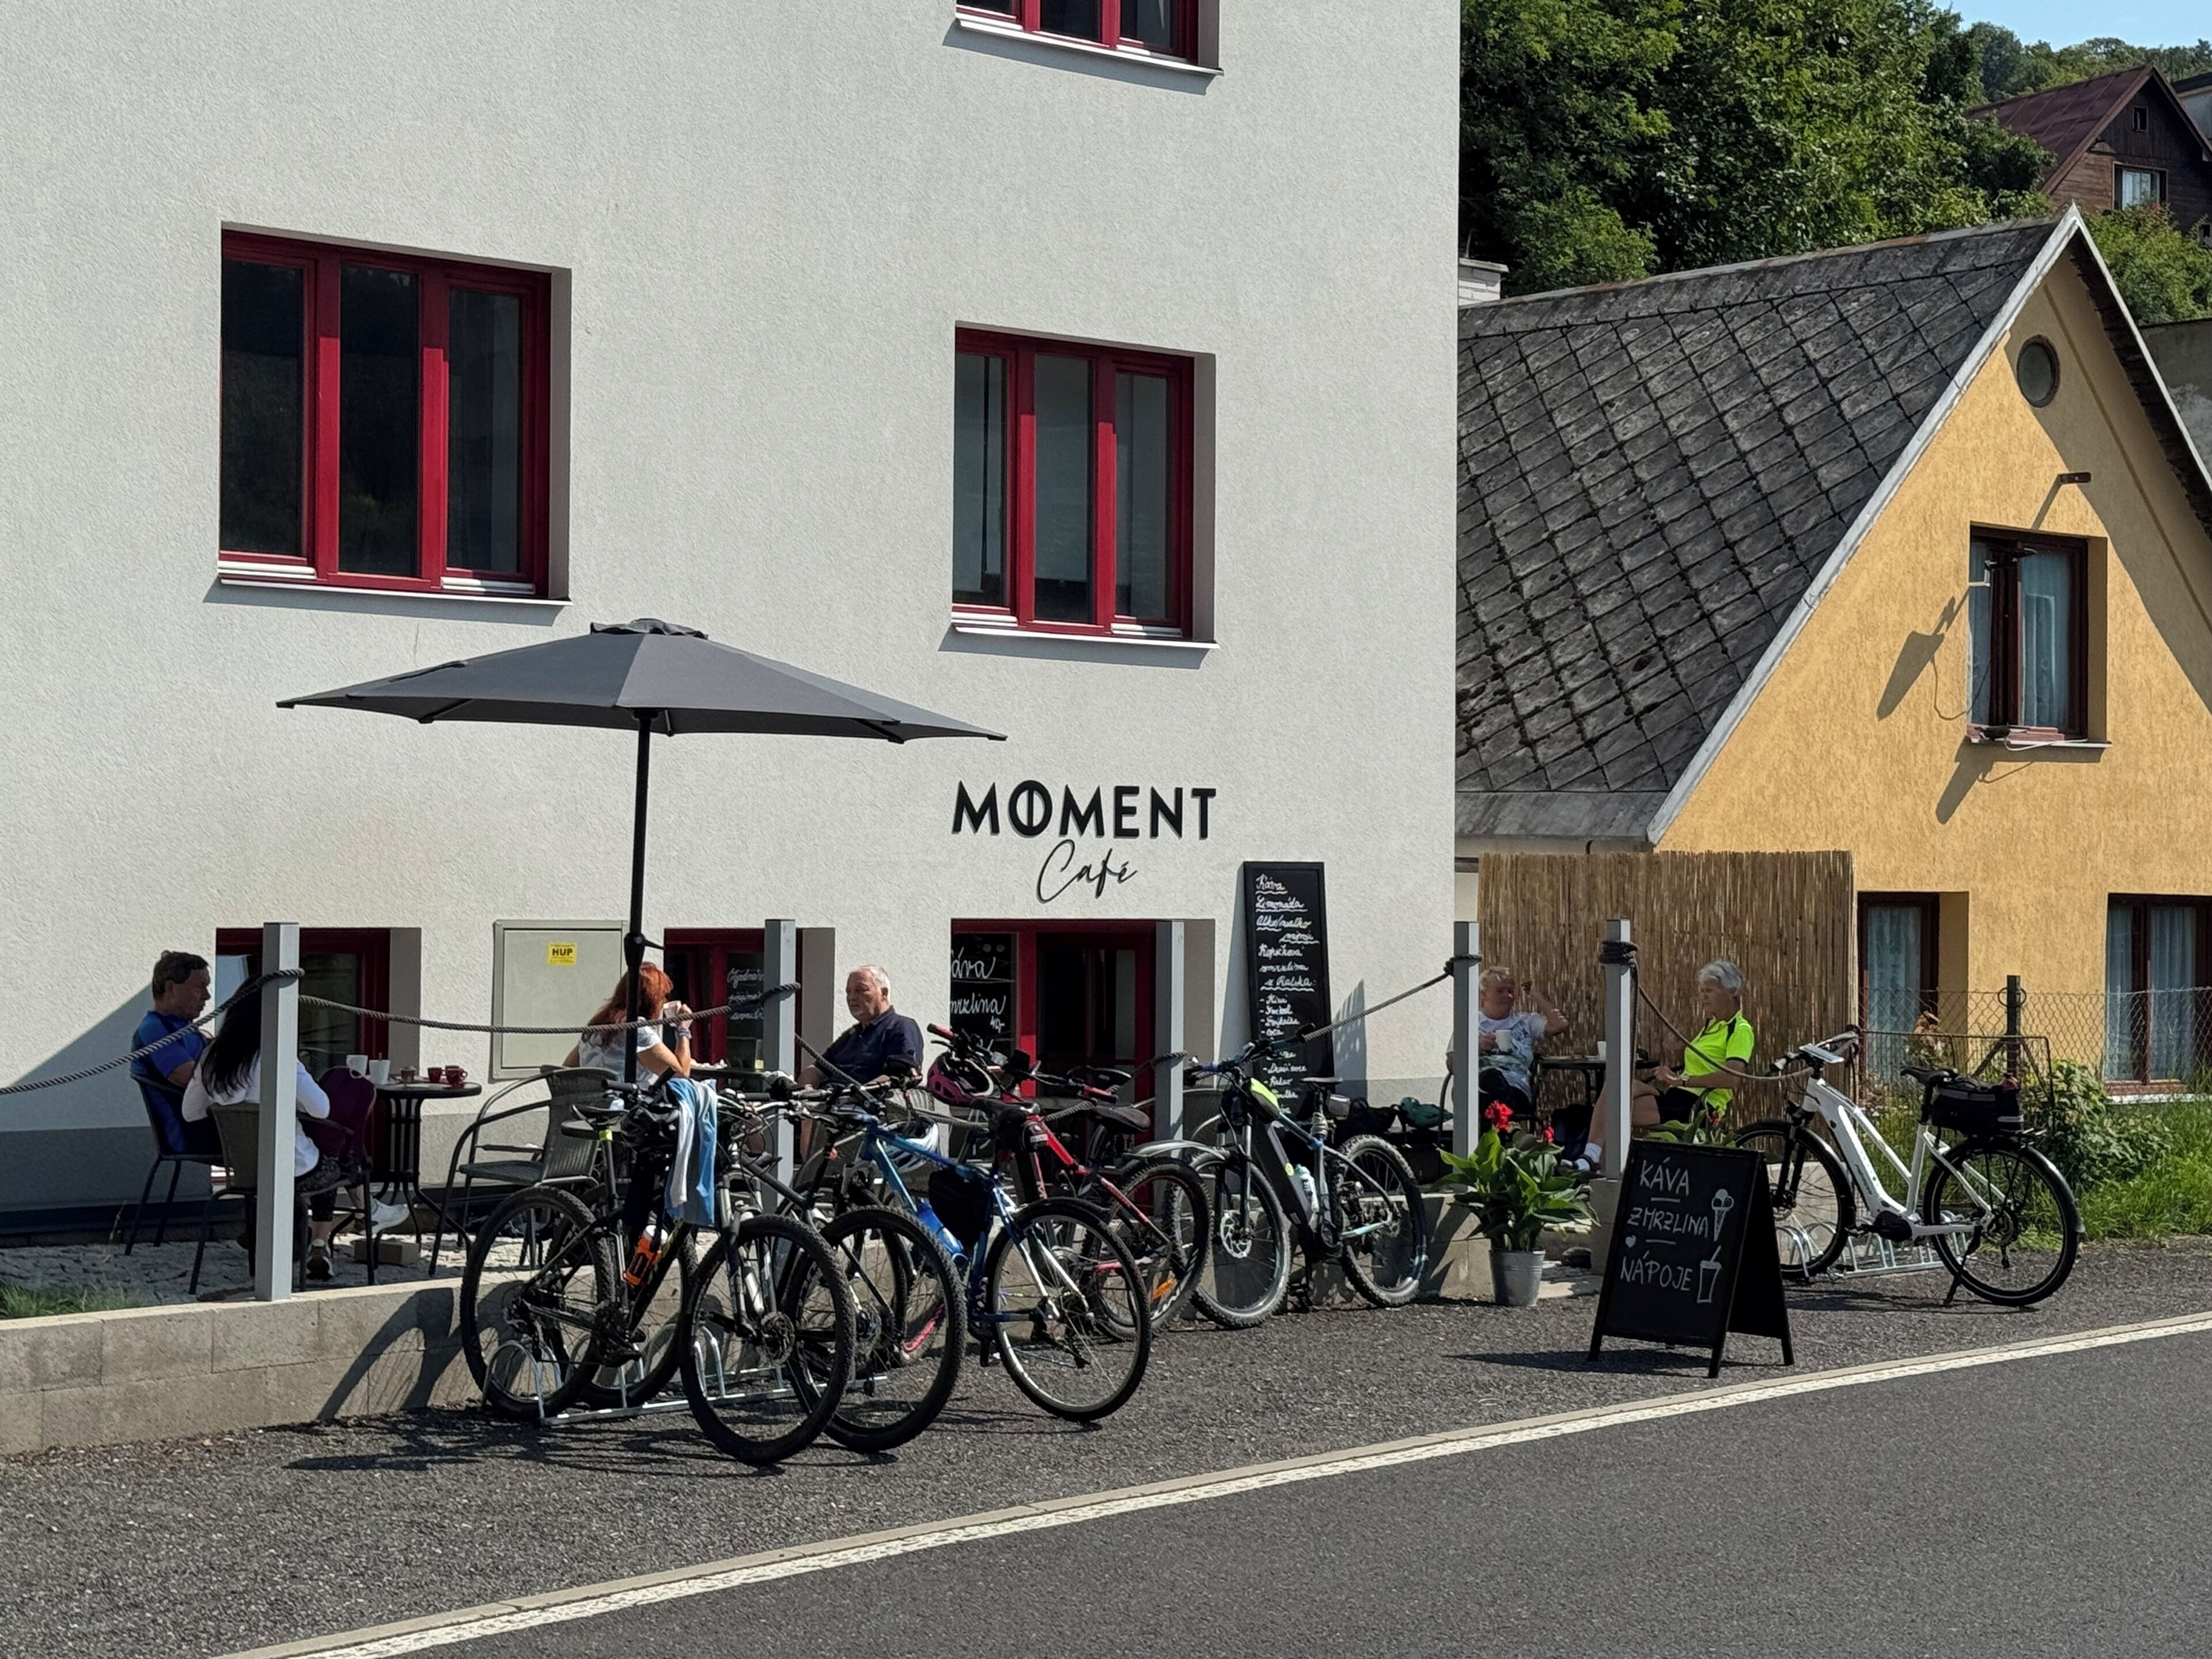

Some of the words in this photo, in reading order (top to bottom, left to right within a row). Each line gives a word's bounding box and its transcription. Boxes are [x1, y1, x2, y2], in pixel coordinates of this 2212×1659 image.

[952, 779, 1217, 839] MOMENT
[1036, 839, 1138, 903] Café
[552, 948, 573, 956] HUP
[950, 946, 996, 979] áva
[950, 993, 1006, 1015] mrzlina
[1639, 1157, 1690, 1195] KÁVA
[1627, 1207, 1709, 1238] ZMRZLINA
[1620, 1251, 1693, 1291] NÁPOJE
